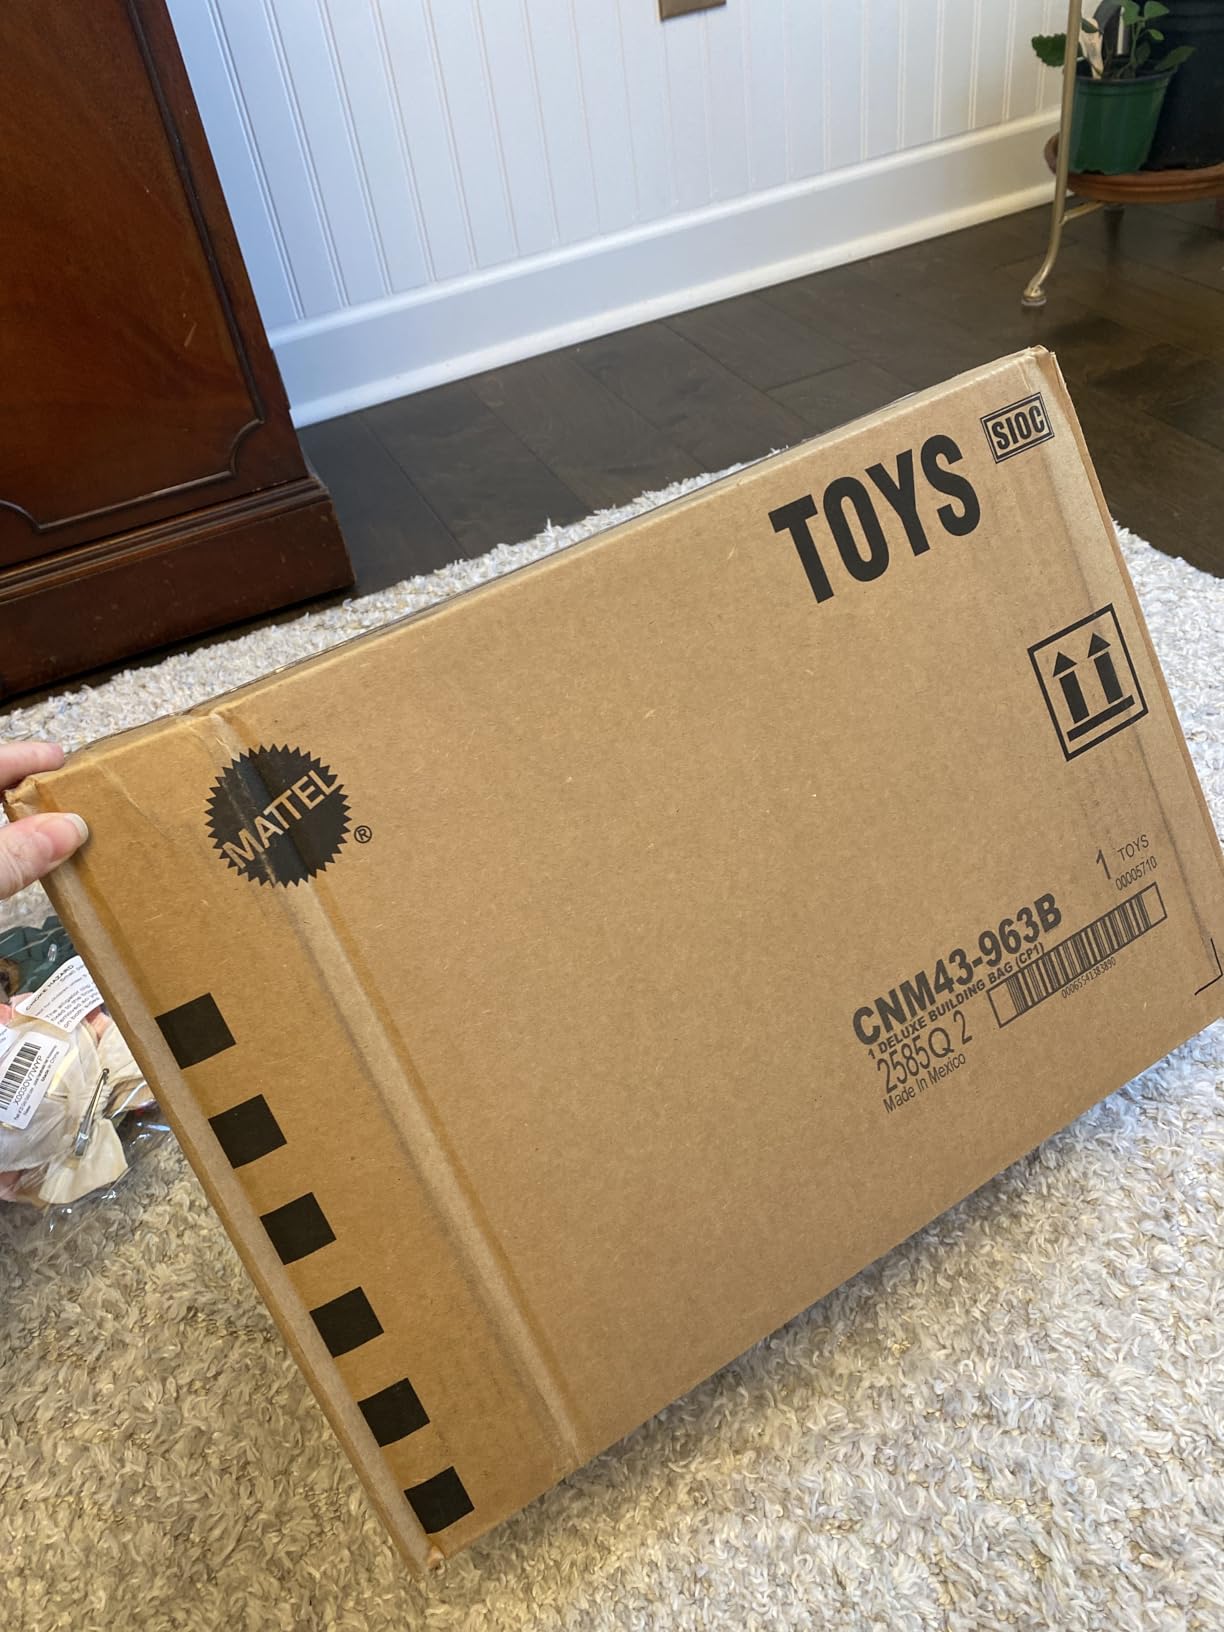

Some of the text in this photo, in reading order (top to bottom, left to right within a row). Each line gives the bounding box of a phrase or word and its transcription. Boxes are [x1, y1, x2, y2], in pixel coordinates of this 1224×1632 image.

[991, 405, 1045, 450] SIOC
[768, 434, 981, 604] TOYS
[222, 770, 339, 869] MATTEL
[1096, 834, 1150, 880] 1 TOYS
[1115, 855, 1158, 891] 00005710
[853, 893, 1062, 1045] CNM43-963B
[868, 942, 1045, 1059] 1 DELUXE BUILDING BAG (CP1)
[877, 1010, 973, 1094] 2585Q 2
[883, 1053, 966, 1113] Made In Mexico
